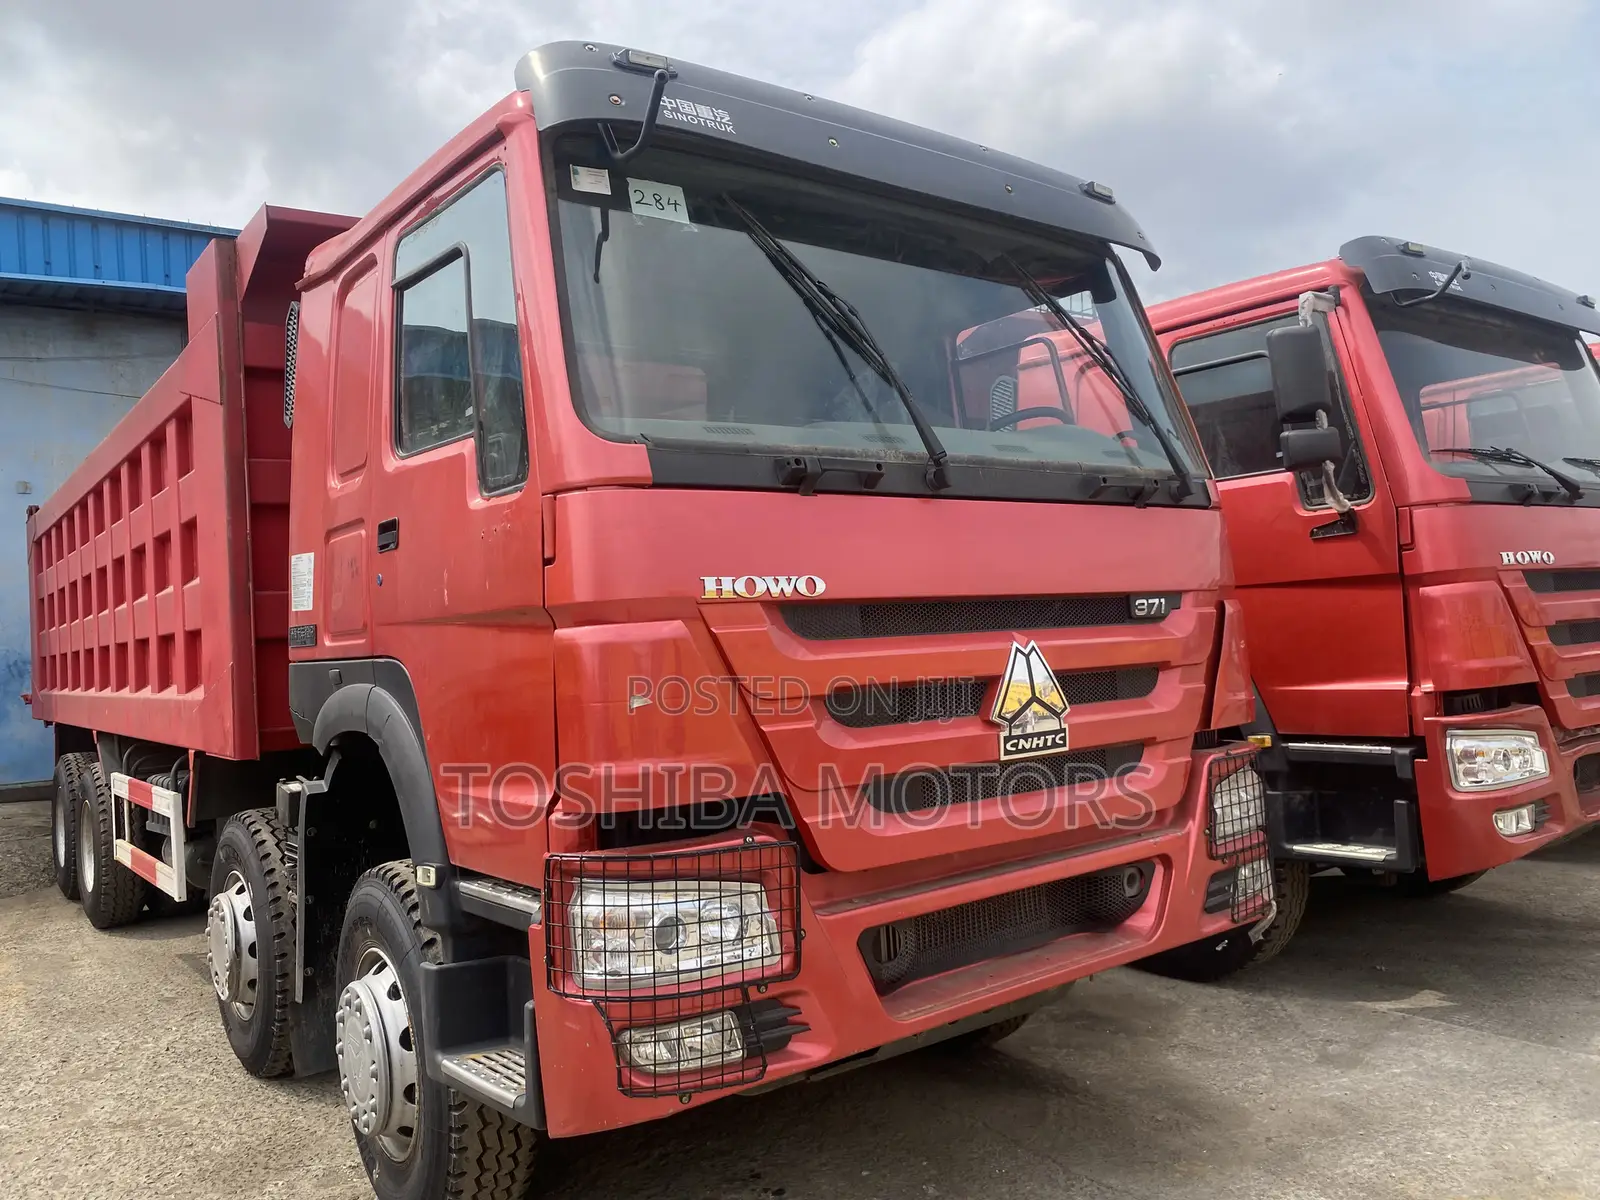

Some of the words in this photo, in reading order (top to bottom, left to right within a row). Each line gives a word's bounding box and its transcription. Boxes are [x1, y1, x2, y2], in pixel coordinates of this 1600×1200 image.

[663, 110, 736, 134] SINOTRUK
[633, 189, 681, 212] 284
[1500, 550, 1555, 565] HOWO
[700, 575, 826, 599] HOWO
[1135, 598, 1165, 616] 371
[1005, 733, 1065, 751] CNHTC
